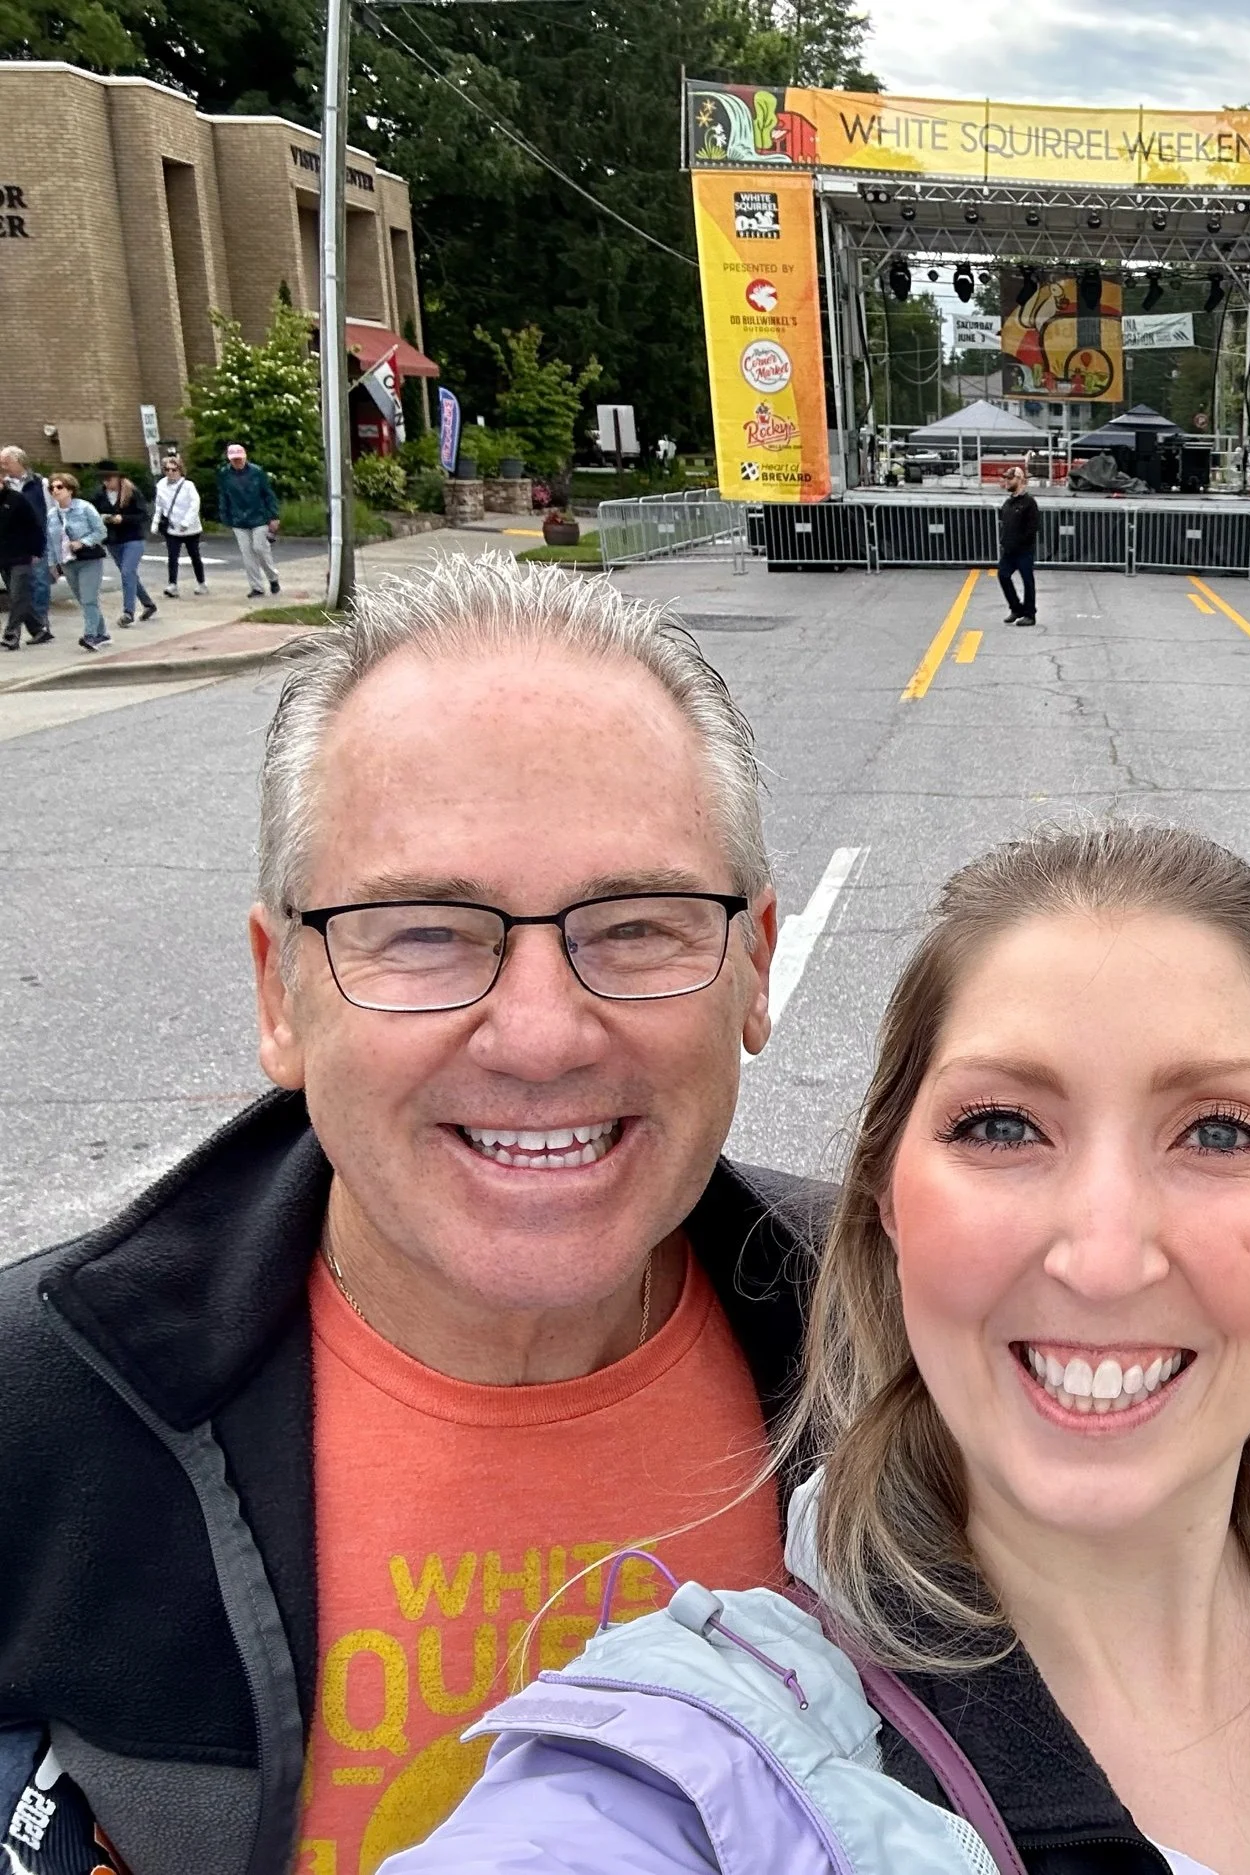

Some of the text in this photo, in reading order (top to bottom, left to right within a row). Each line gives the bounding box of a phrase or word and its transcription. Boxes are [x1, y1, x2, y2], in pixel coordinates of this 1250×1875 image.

[839, 112, 948, 150] WHITE
[960, 121, 1119, 161] SQUIRREL
[740, 193, 771, 202] WHITE
[735, 202, 778, 211] SQUIRREL
[723, 263, 795, 273] PRESENTED BY
[956, 320, 993, 330] SATURDAY
[958, 333, 975, 342] JUNE
[743, 416, 796, 444] Rocky's
[761, 463, 800, 472] Heart of
[761, 473, 812, 482] BREVARD
[388, 1541, 659, 1621] WHITE
[9, 1786, 56, 1851] 2023
